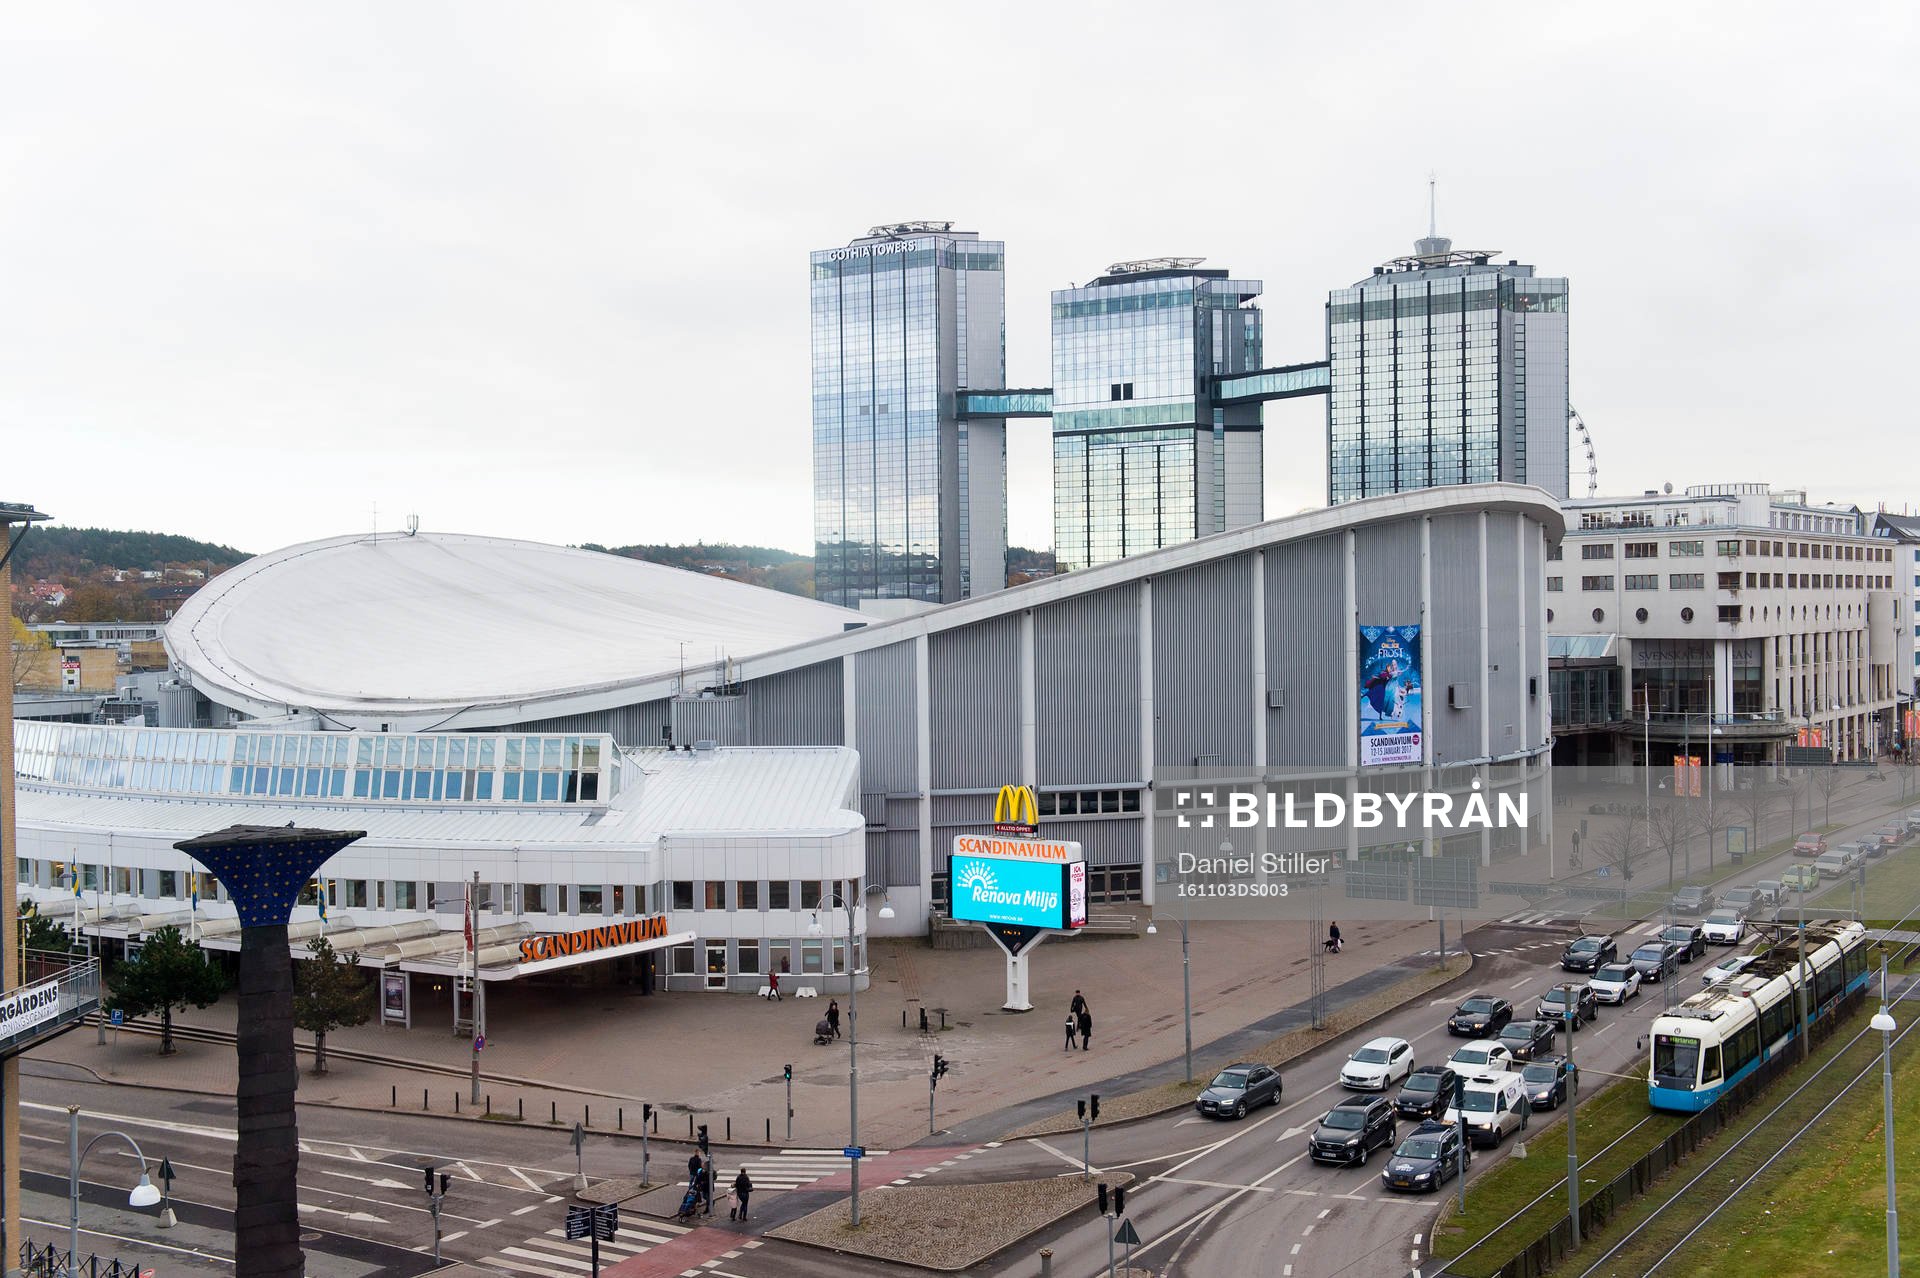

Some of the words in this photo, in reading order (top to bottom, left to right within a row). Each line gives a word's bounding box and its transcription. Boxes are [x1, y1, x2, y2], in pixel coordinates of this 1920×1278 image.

[830, 246, 871, 261] GOTHIA
[871, 240, 917, 256] TOWERS
[1377, 648, 1404, 659] FROST
[1370, 736, 1412, 747] SCANDINAVIUM
[959, 838, 1067, 859] SCANDINAVIUM
[972, 886, 1021, 905] Renova
[1023, 890, 1058, 912] Miljö
[519, 915, 669, 963] SCANDINAVIUM
[0, 985, 57, 1023] RGÅRDENS
